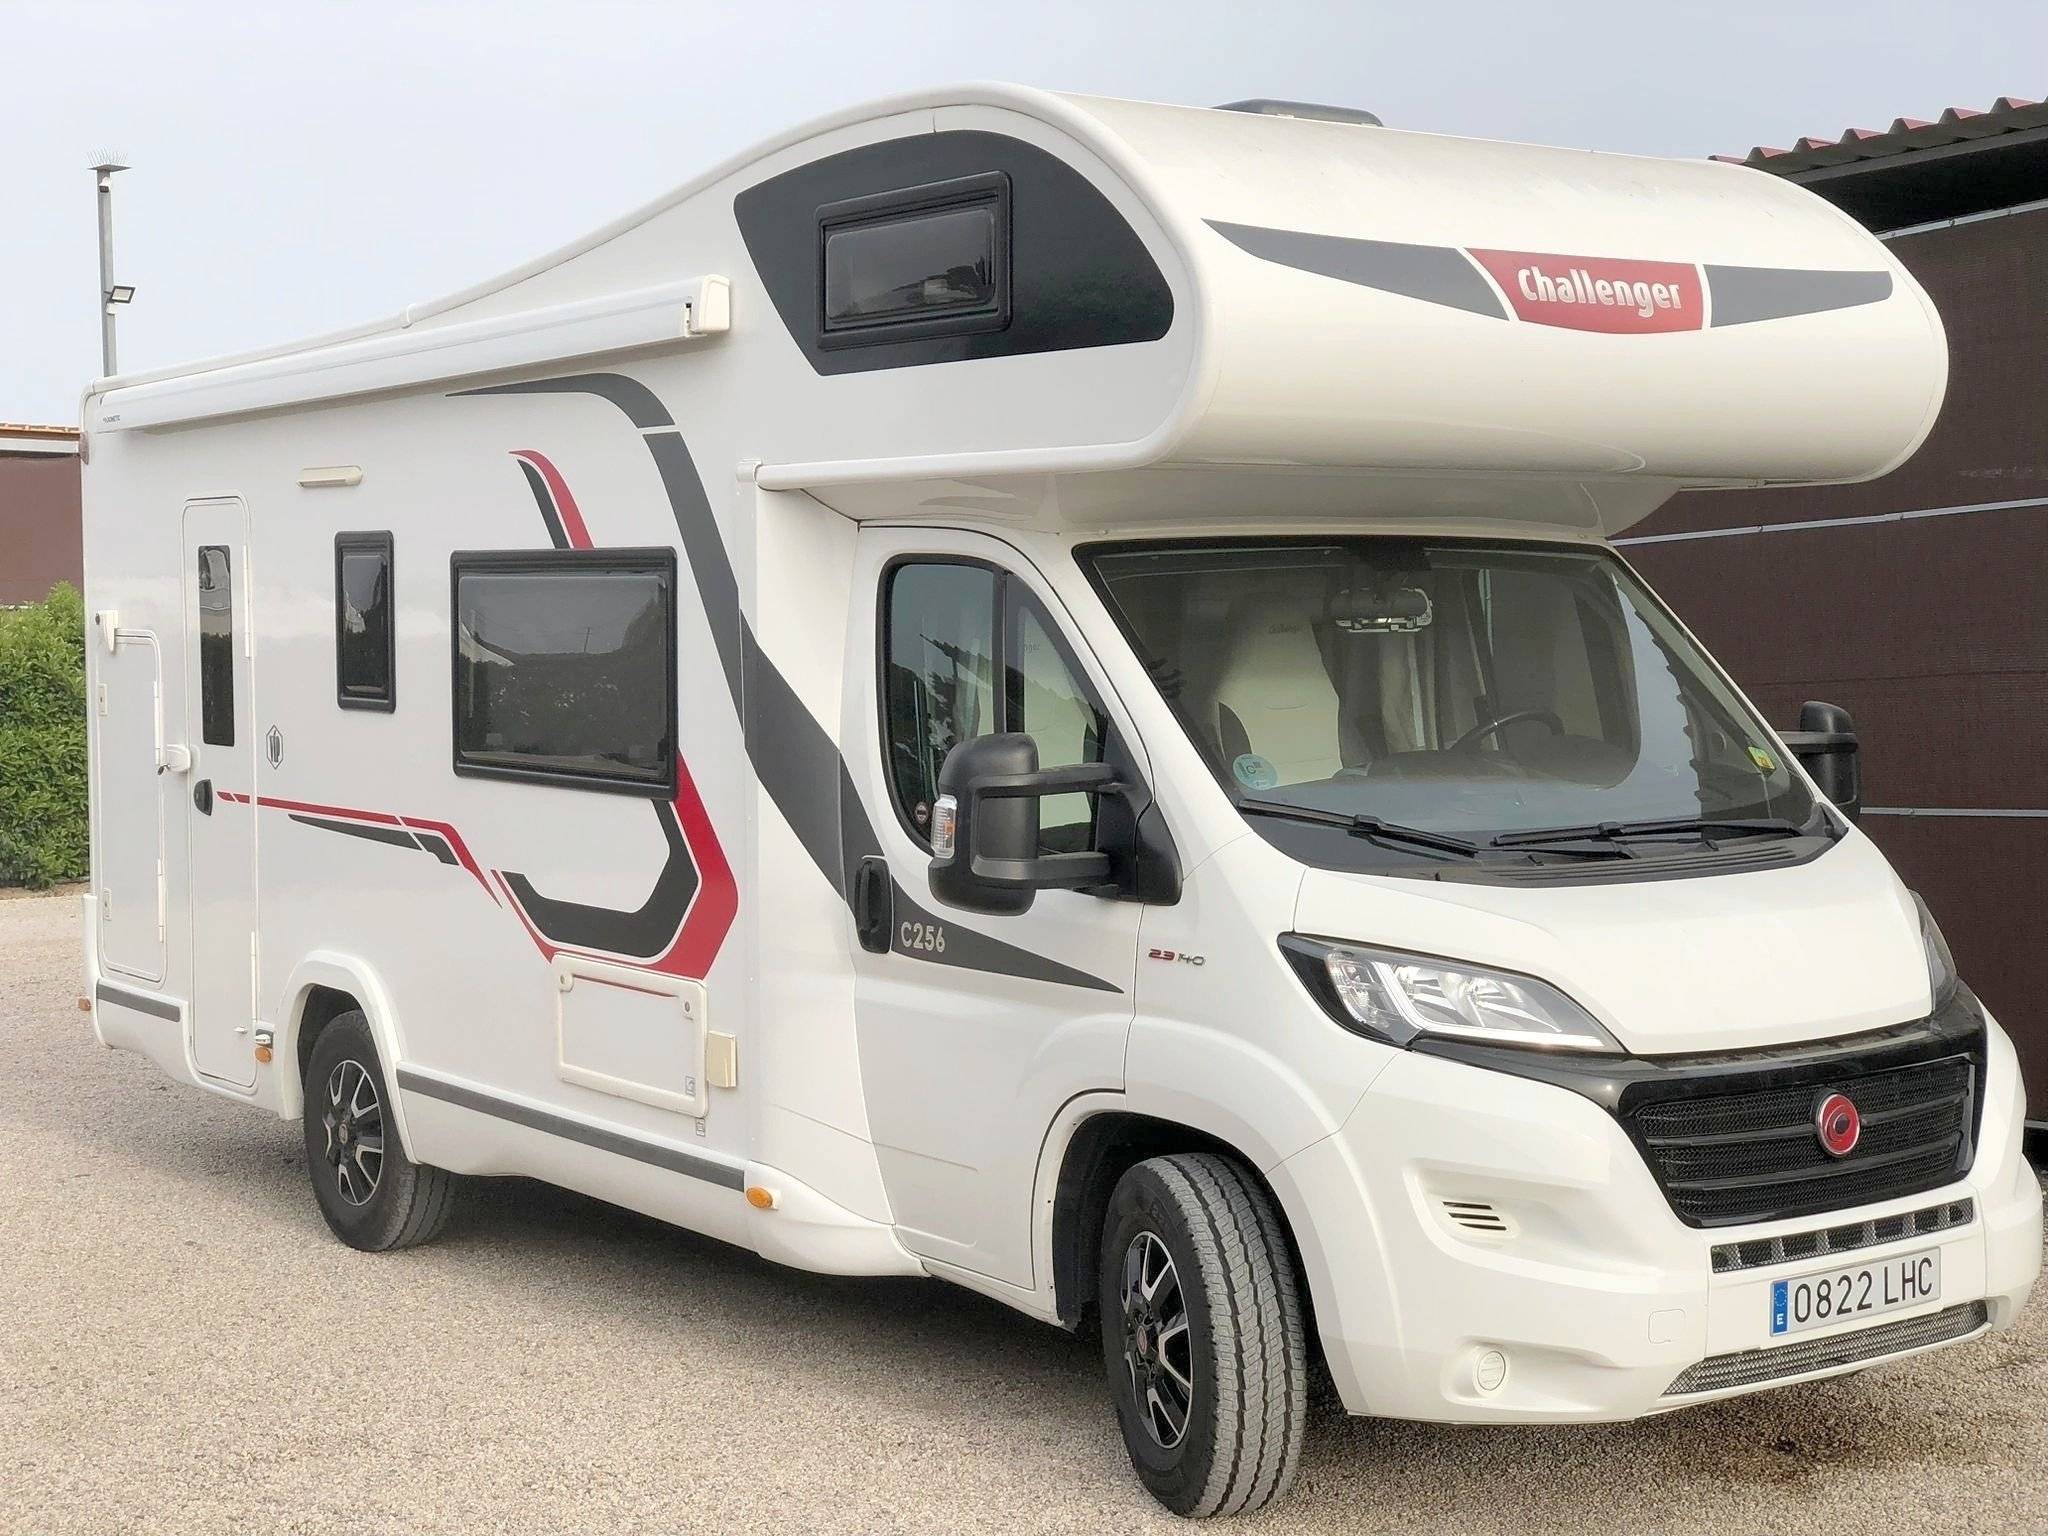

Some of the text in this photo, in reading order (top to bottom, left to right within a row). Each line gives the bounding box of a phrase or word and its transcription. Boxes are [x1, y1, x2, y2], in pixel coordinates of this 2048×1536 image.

[1517, 265, 1682, 318] Challenger
[901, 921, 946, 953] C256
[1177, 952, 1206, 966] 140
[1794, 1257, 1933, 1323] 0822 LHC
